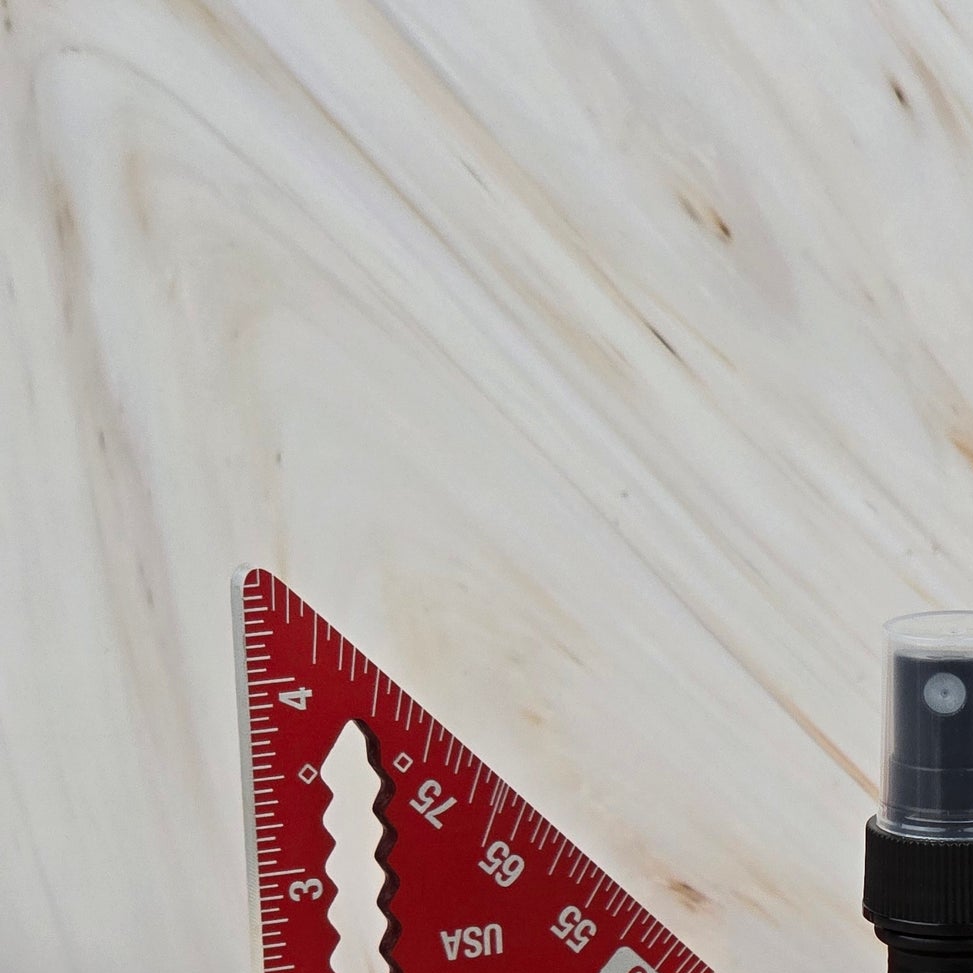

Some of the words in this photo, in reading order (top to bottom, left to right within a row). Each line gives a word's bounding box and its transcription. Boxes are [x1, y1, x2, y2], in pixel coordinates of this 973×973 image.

[278, 687, 312, 710] 4
[409, 779, 457, 828] 75
[478, 840, 525, 888] 65
[289, 878, 323, 901] 3
[440, 923, 503, 961] USA
[550, 905, 597, 953] 55
